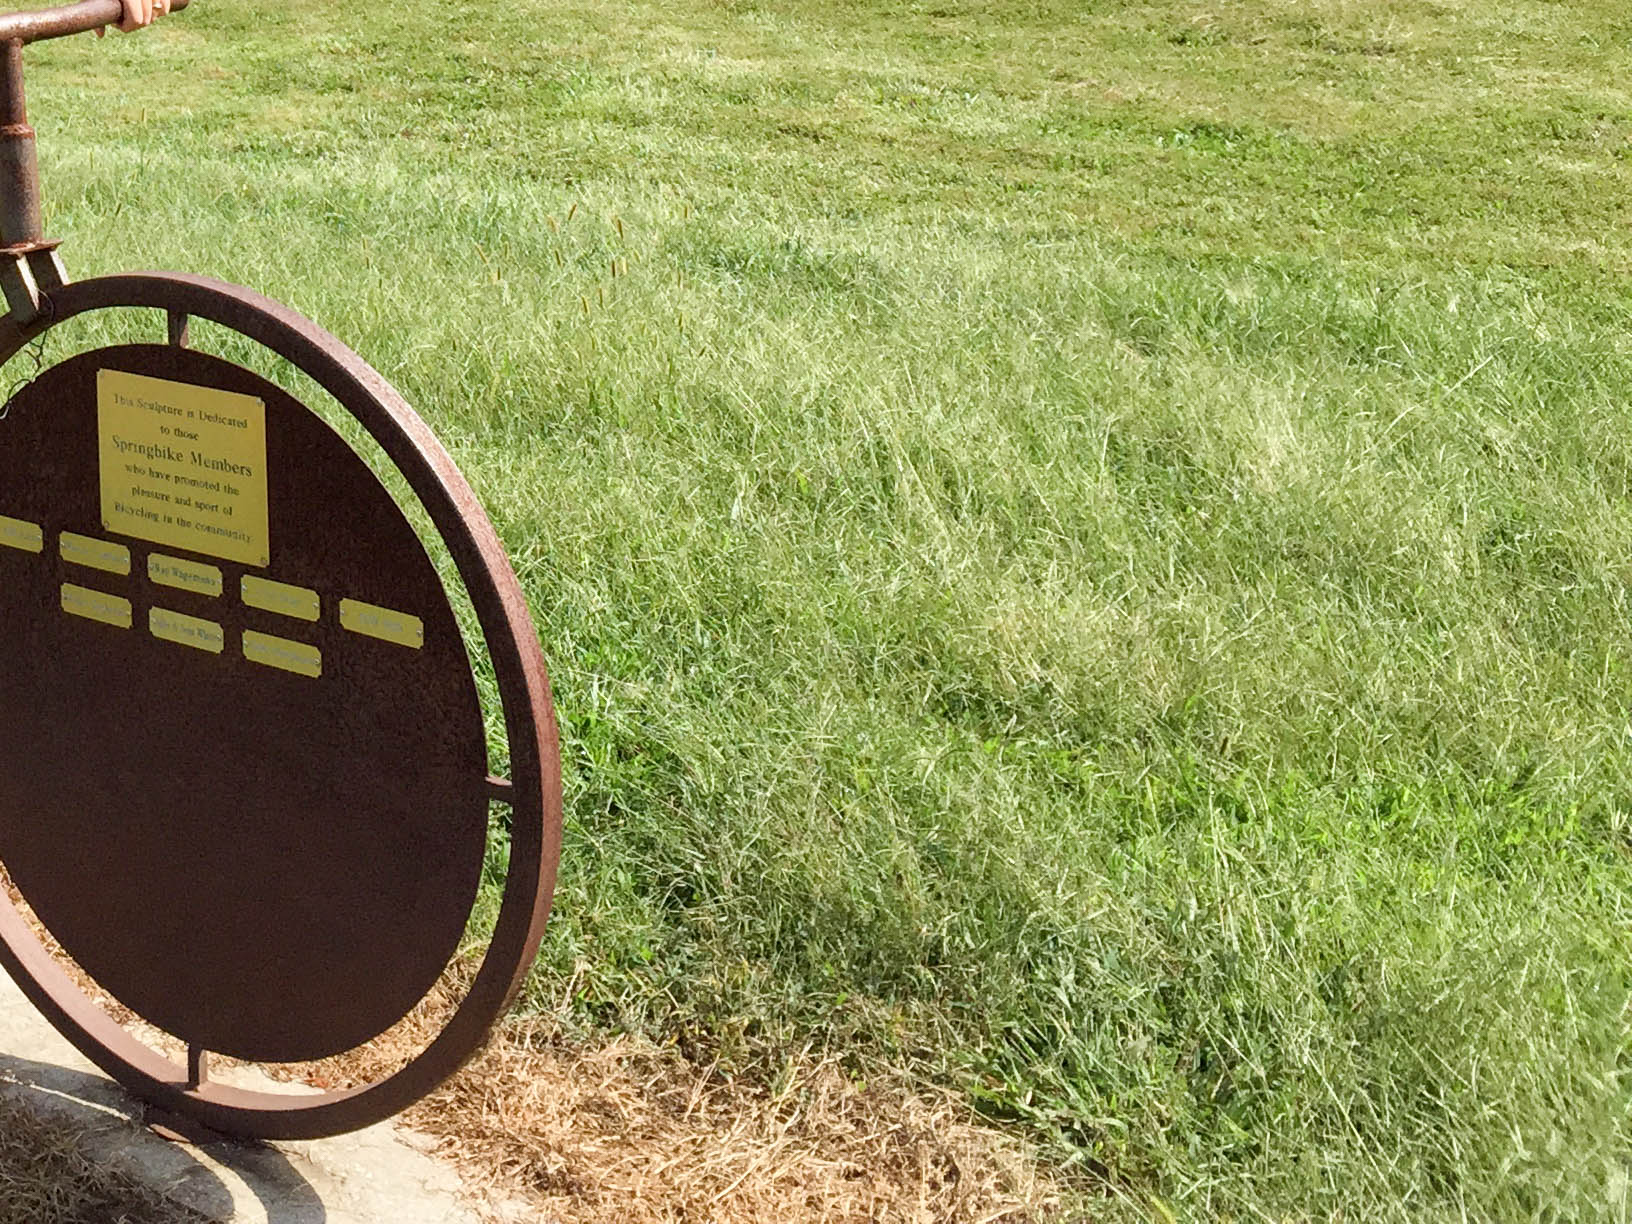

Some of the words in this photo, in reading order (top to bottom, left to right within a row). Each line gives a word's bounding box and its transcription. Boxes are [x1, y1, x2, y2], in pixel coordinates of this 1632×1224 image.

[114, 393, 133, 406] This
[137, 398, 183, 415] Sculpture
[199, 410, 248, 429] Dedicated
[160, 424, 170, 436] to
[174, 427, 200, 441] those
[112, 434, 184, 463] Springbike
[190, 450, 253, 477] Members
[125, 463, 146, 476] who
[149, 466, 171, 482] have
[174, 474, 221, 493] promoted
[224, 483, 240, 496] the
[115, 503, 159, 522] Bicycling
[163, 513, 173, 524] in
[176, 516, 192, 528] the
[131, 485, 171, 502] pleasure
[174, 495, 192, 507] and
[194, 500, 219, 513] sport
[223, 506, 233, 516] of
